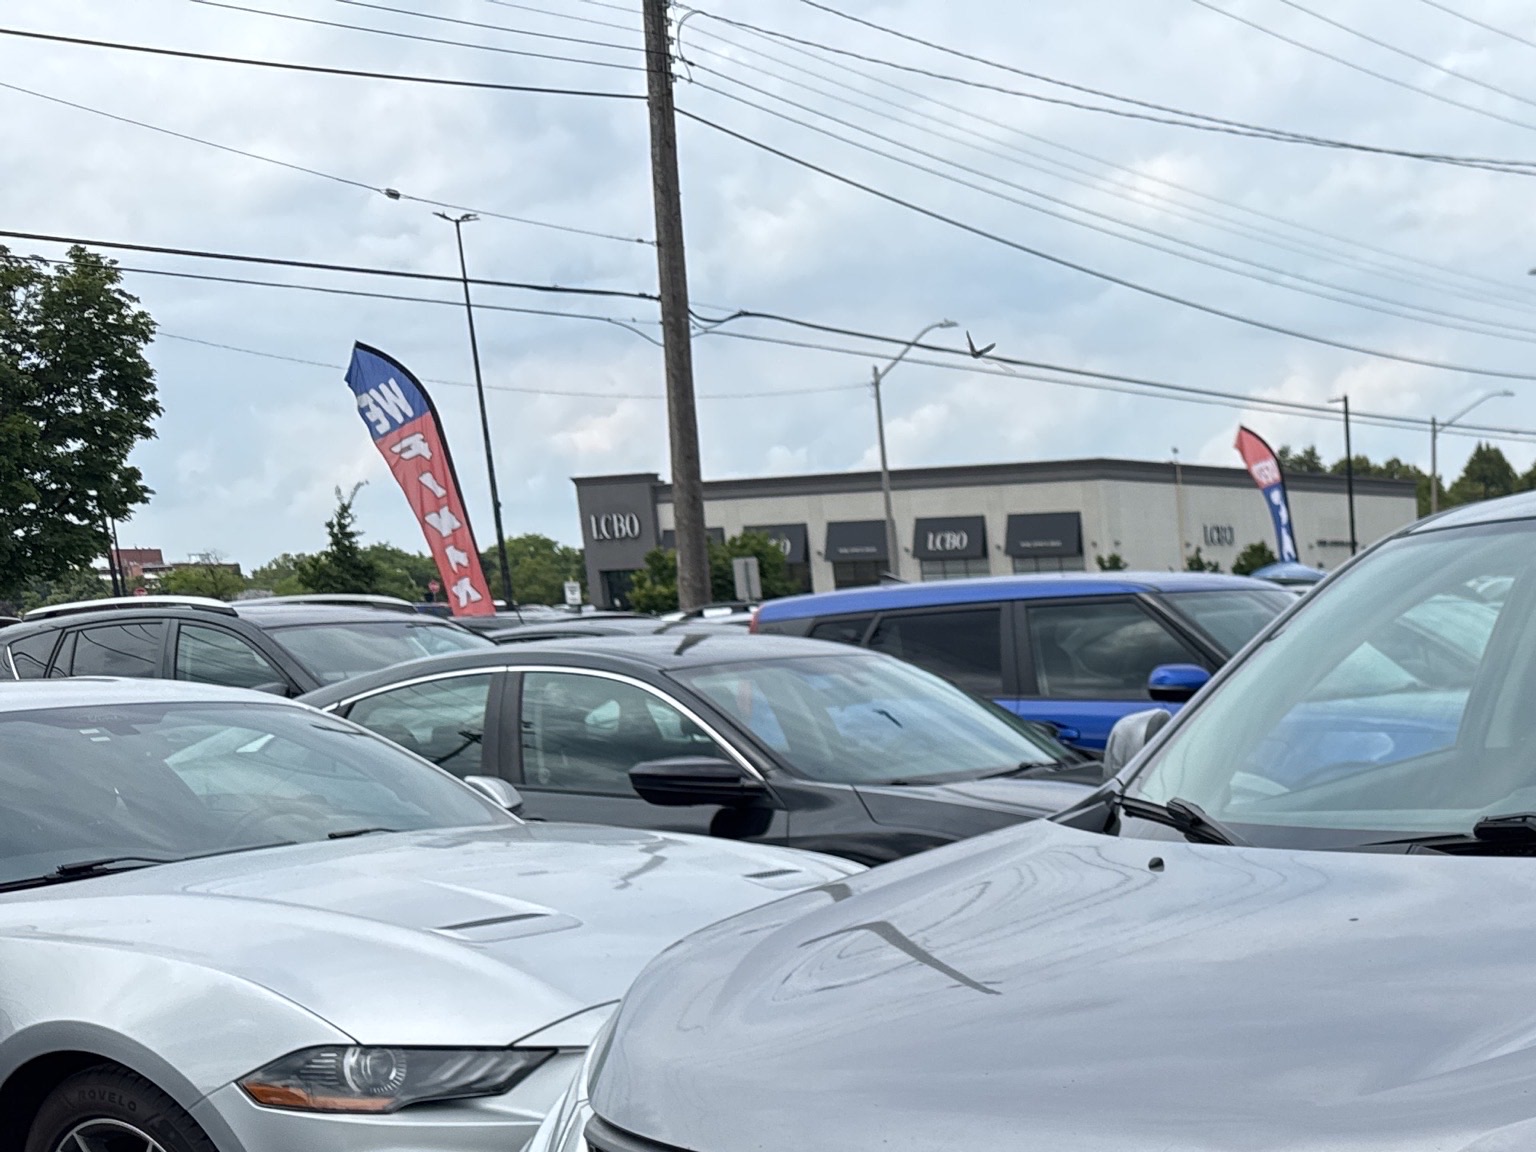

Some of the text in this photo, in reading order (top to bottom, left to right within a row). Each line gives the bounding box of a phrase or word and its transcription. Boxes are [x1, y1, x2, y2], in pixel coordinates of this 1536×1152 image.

[590, 512, 640, 540] LCBO
[926, 530, 968, 551] LCBO
[78, 1089, 137, 1112] ROVELO
